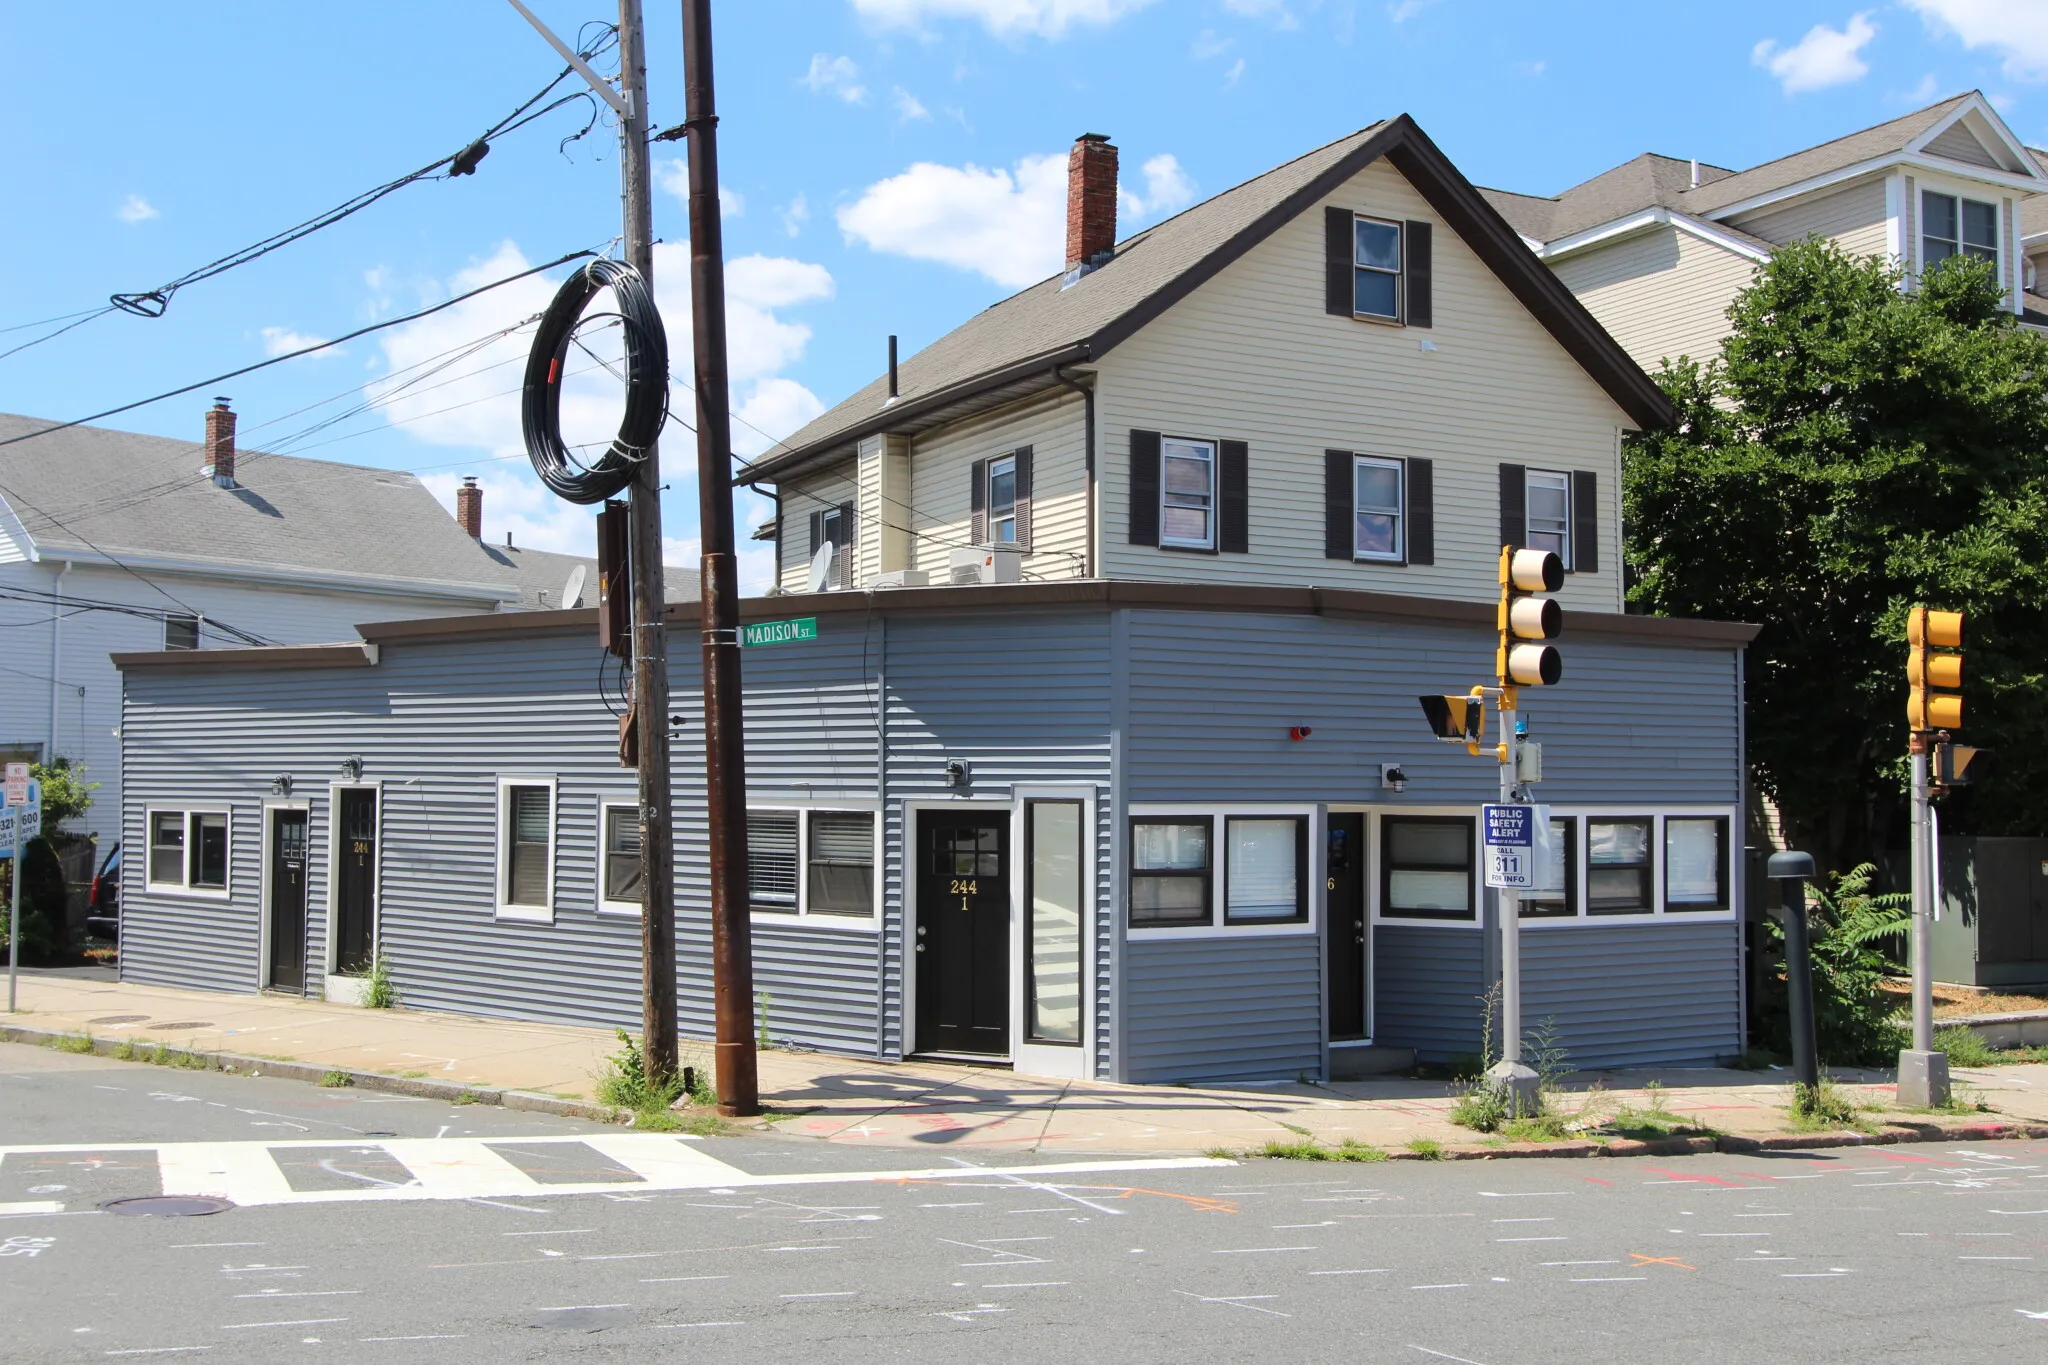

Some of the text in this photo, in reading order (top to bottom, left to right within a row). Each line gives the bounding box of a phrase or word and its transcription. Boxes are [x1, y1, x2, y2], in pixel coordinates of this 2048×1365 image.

[747, 623, 810, 644] MADISON ST
[1489, 809, 1523, 818] PUBLIC
[1489, 819, 1524, 828] SAFETY
[1491, 828, 1521, 837] ALERT
[353, 841, 369, 854] 244
[1495, 856, 1518, 872] 311
[1327, 877, 1335, 890] 6
[1504, 875, 1525, 883] INFO
[950, 879, 978, 895] 244
[961, 896, 968, 911] 1
